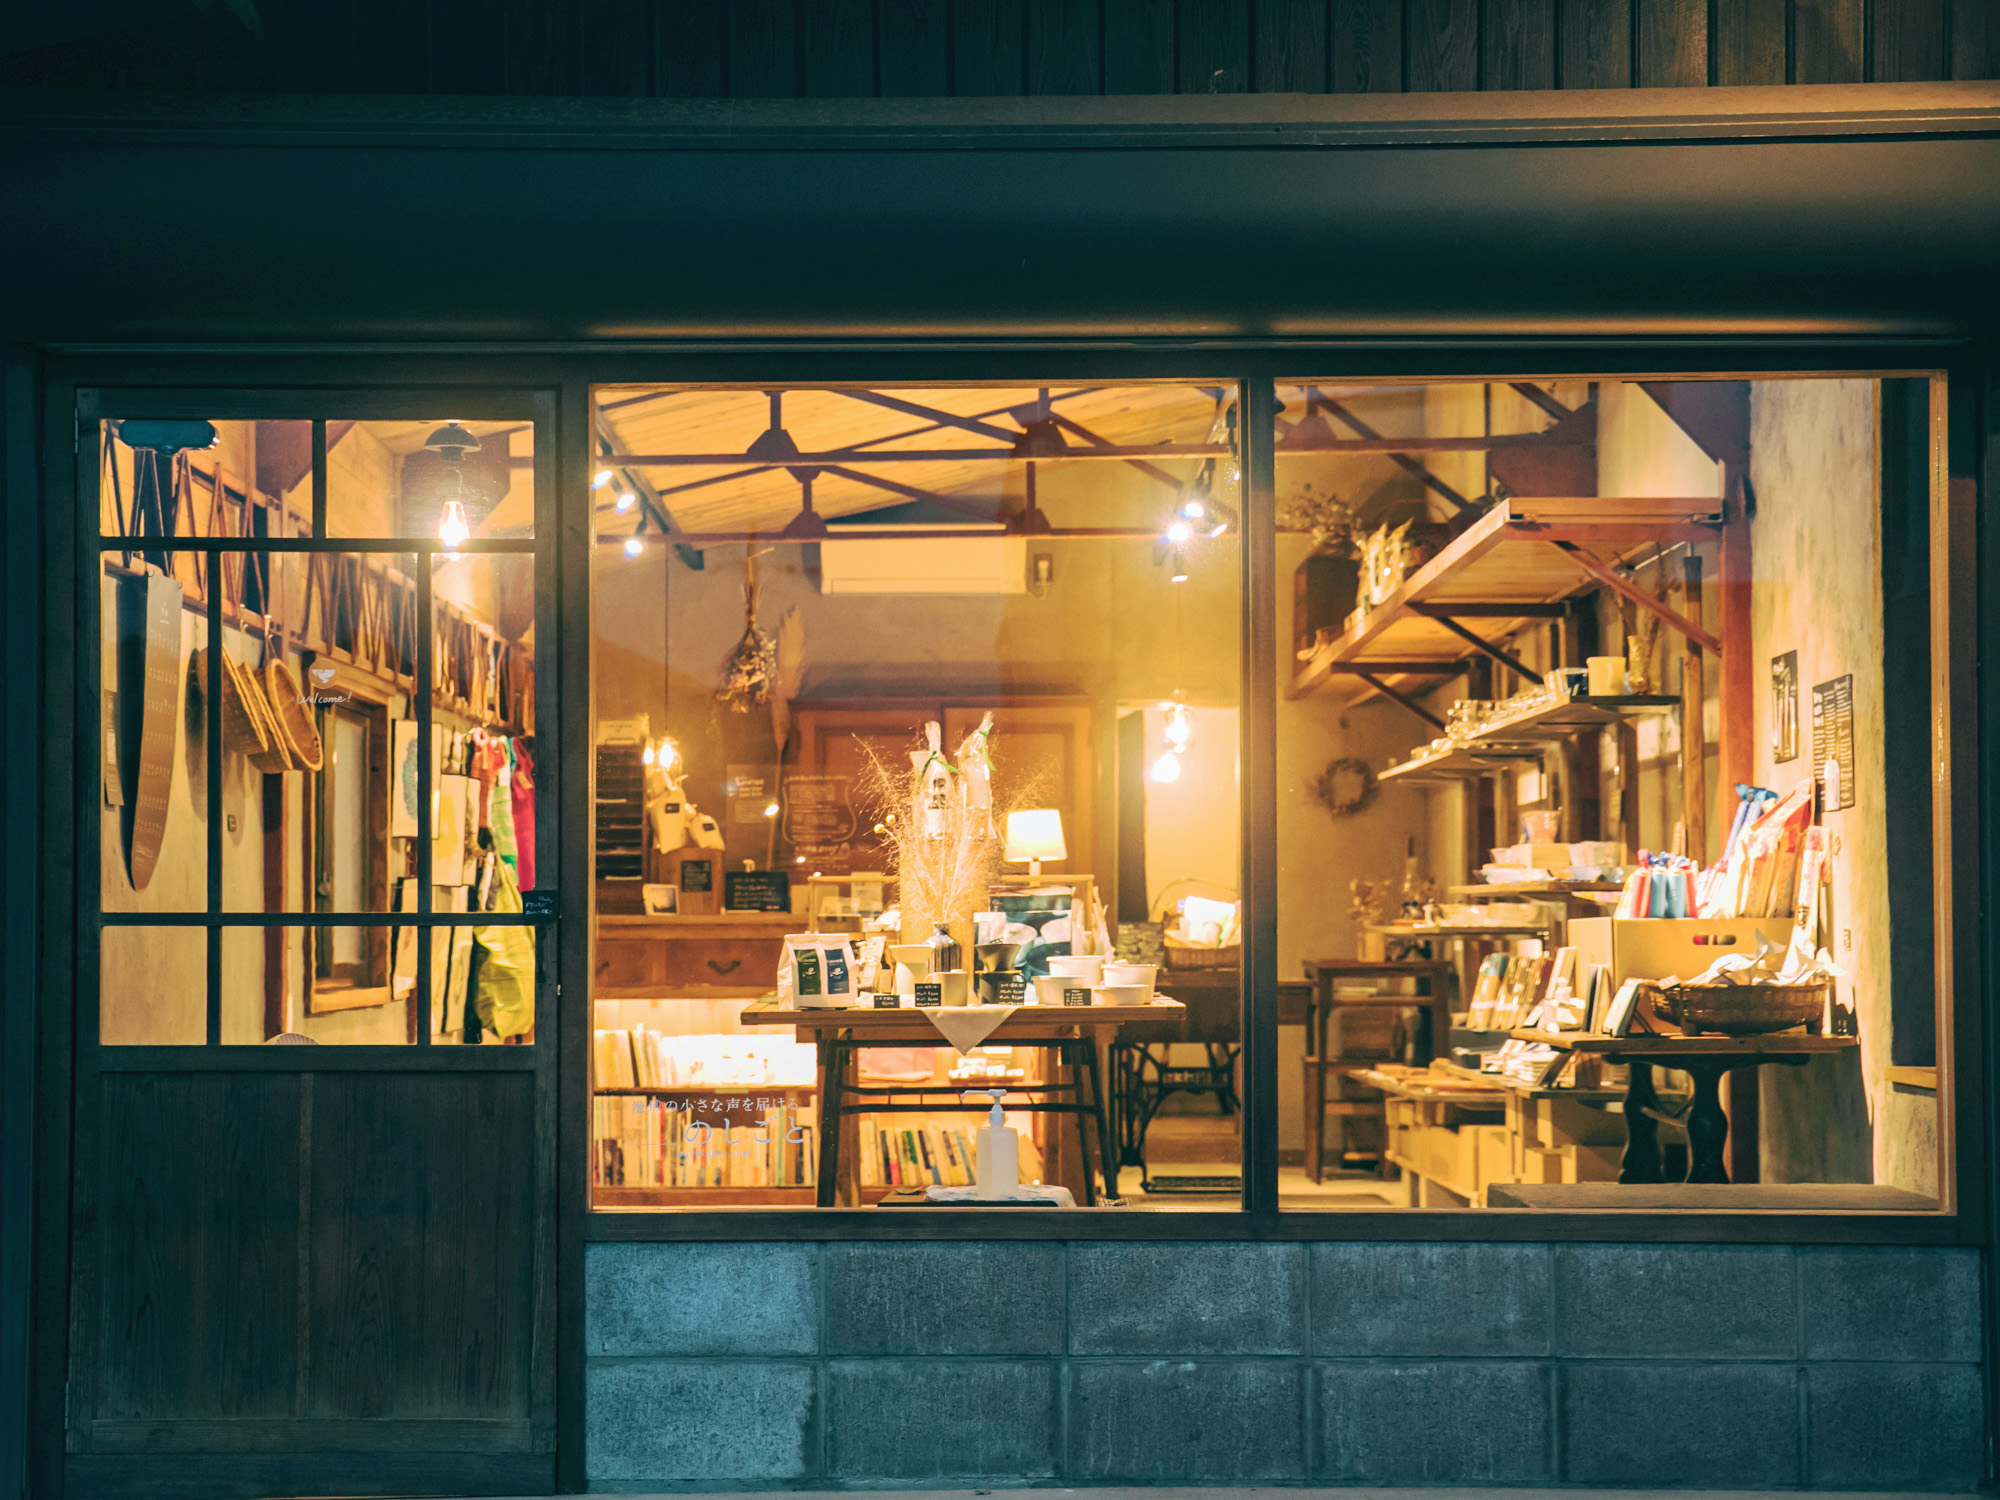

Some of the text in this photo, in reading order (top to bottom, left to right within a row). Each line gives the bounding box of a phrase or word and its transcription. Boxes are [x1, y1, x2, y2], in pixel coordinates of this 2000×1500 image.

[296, 691, 352, 705] Welcome!
[632, 1097, 798, 1113] 地域の小さな声を届ける
[685, 1116, 804, 1146] のしごと
